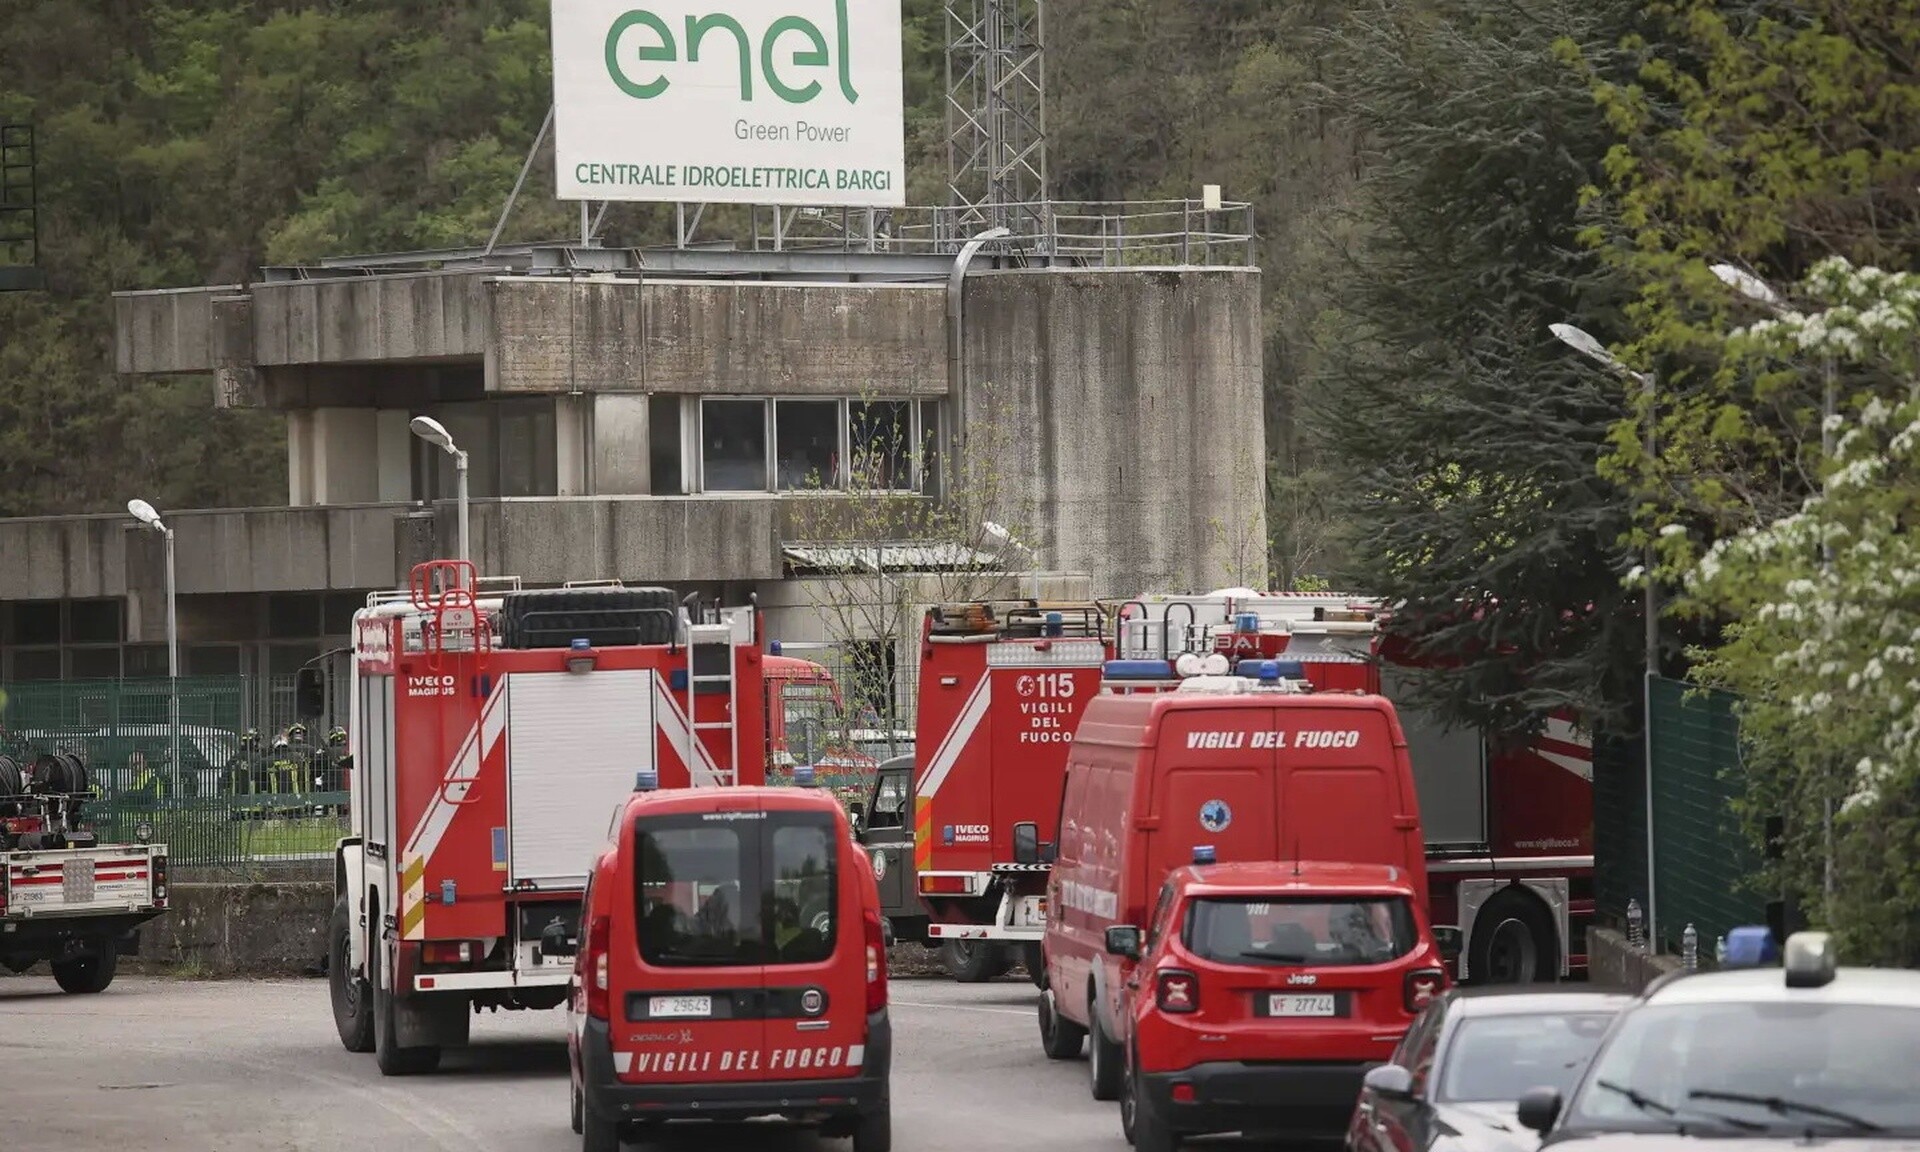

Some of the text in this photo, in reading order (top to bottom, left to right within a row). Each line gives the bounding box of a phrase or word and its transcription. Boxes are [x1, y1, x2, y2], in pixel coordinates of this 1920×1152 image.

[605, 0, 859, 105] enel
[735, 119, 851, 142] Green Power
[575, 163, 891, 190] CENTRALE IDROELETTRICA BARGI
[1214, 635, 1260, 650] BAI
[1037, 673, 1074, 697] 115
[1020, 702, 1072, 714] VIGILI
[1031, 717, 1060, 727] DEL
[1020, 731, 1072, 742] FUOCO
[1187, 730, 1360, 748] VIGILI DEL FUOCO
[955, 825, 989, 834] IVECO
[1287, 973, 1316, 985] Jeep
[651, 999, 709, 1012] VF 29643
[1273, 998, 1331, 1012] VF 27744
[638, 1047, 843, 1072] VIGILI DEL FUOCO
